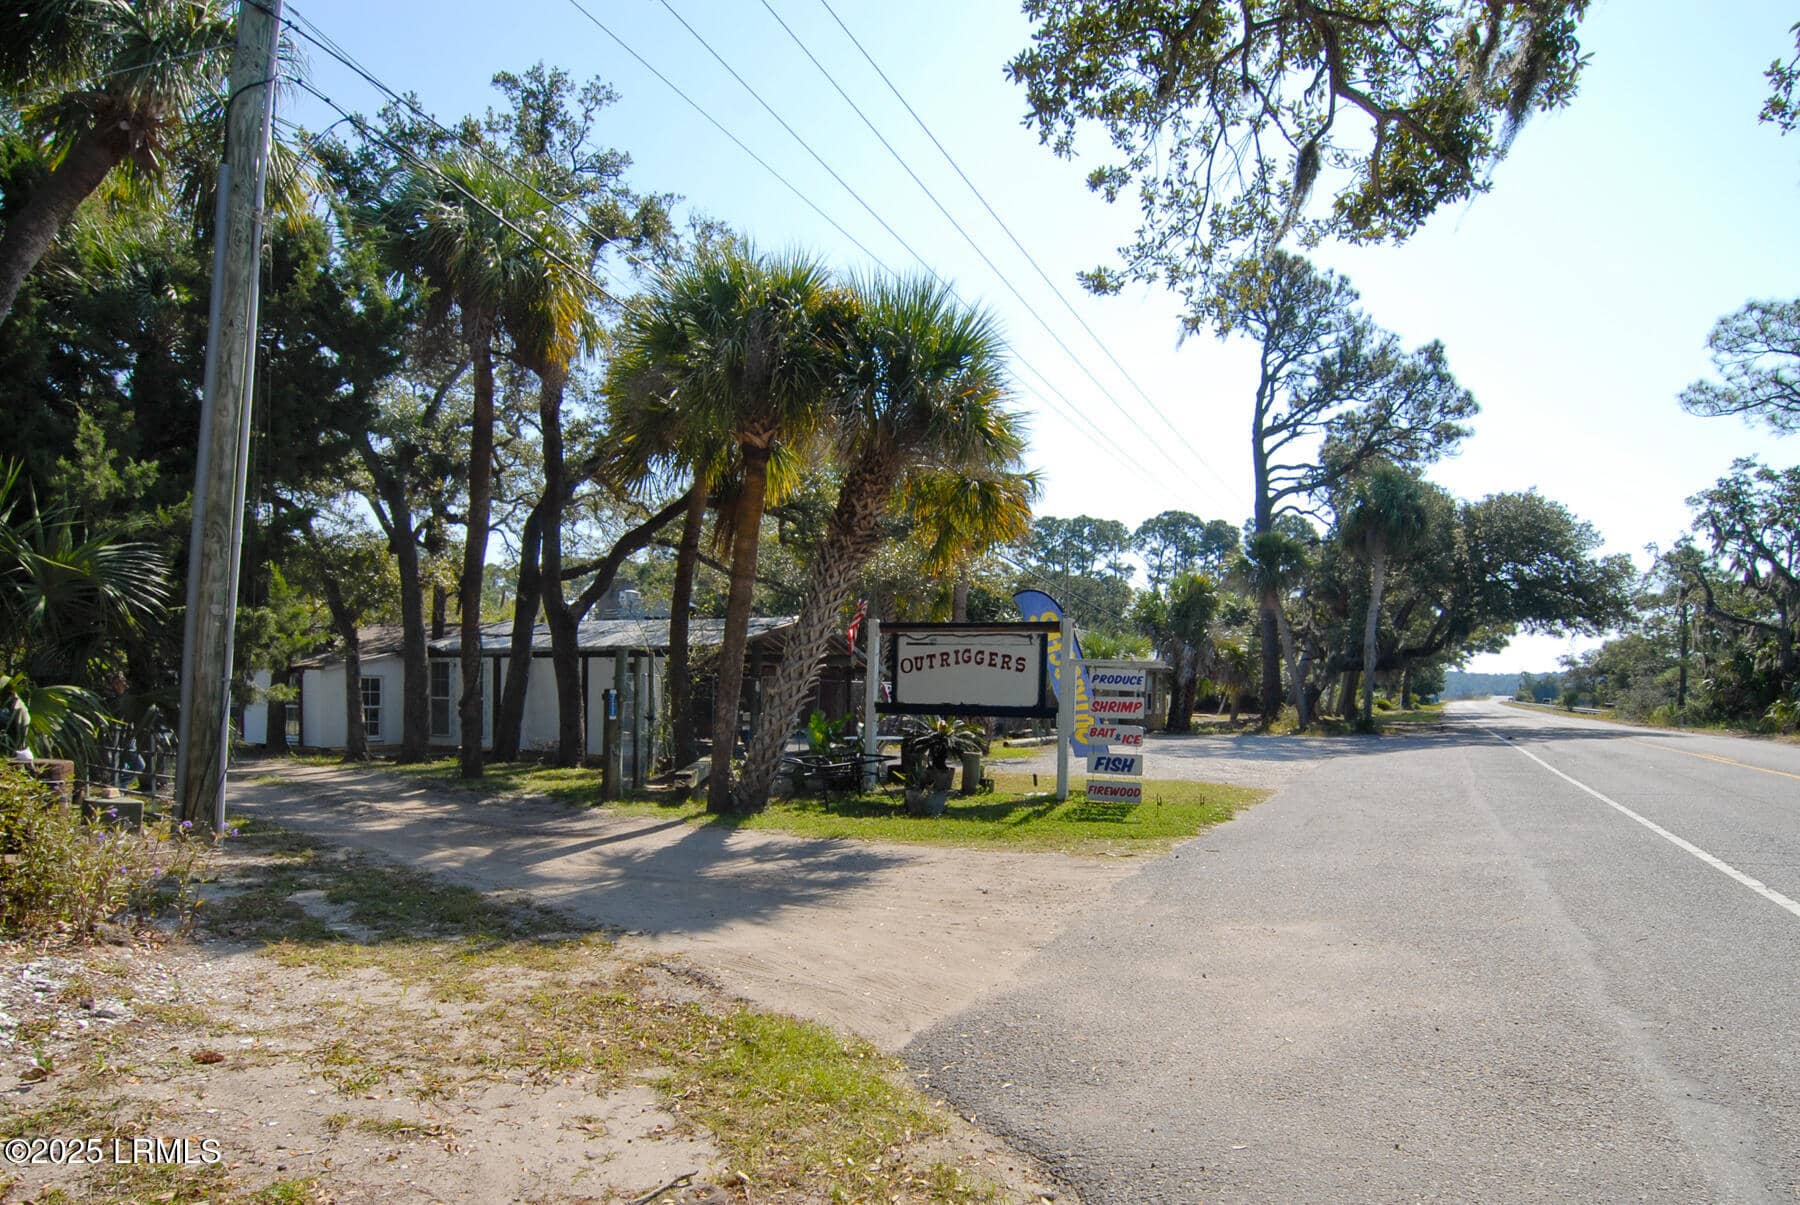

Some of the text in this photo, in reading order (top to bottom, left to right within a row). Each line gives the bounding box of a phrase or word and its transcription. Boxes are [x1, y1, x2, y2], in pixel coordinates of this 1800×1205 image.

[900, 648, 1027, 674] OUTRIGGERS
[1091, 674, 1144, 686] PRODUCE
[1090, 700, 1143, 713] SHRIMP
[1089, 727, 1142, 745] BAIT & ICE
[1094, 756, 1136, 772] FISH
[1088, 785, 1142, 798] FIREWOOD
